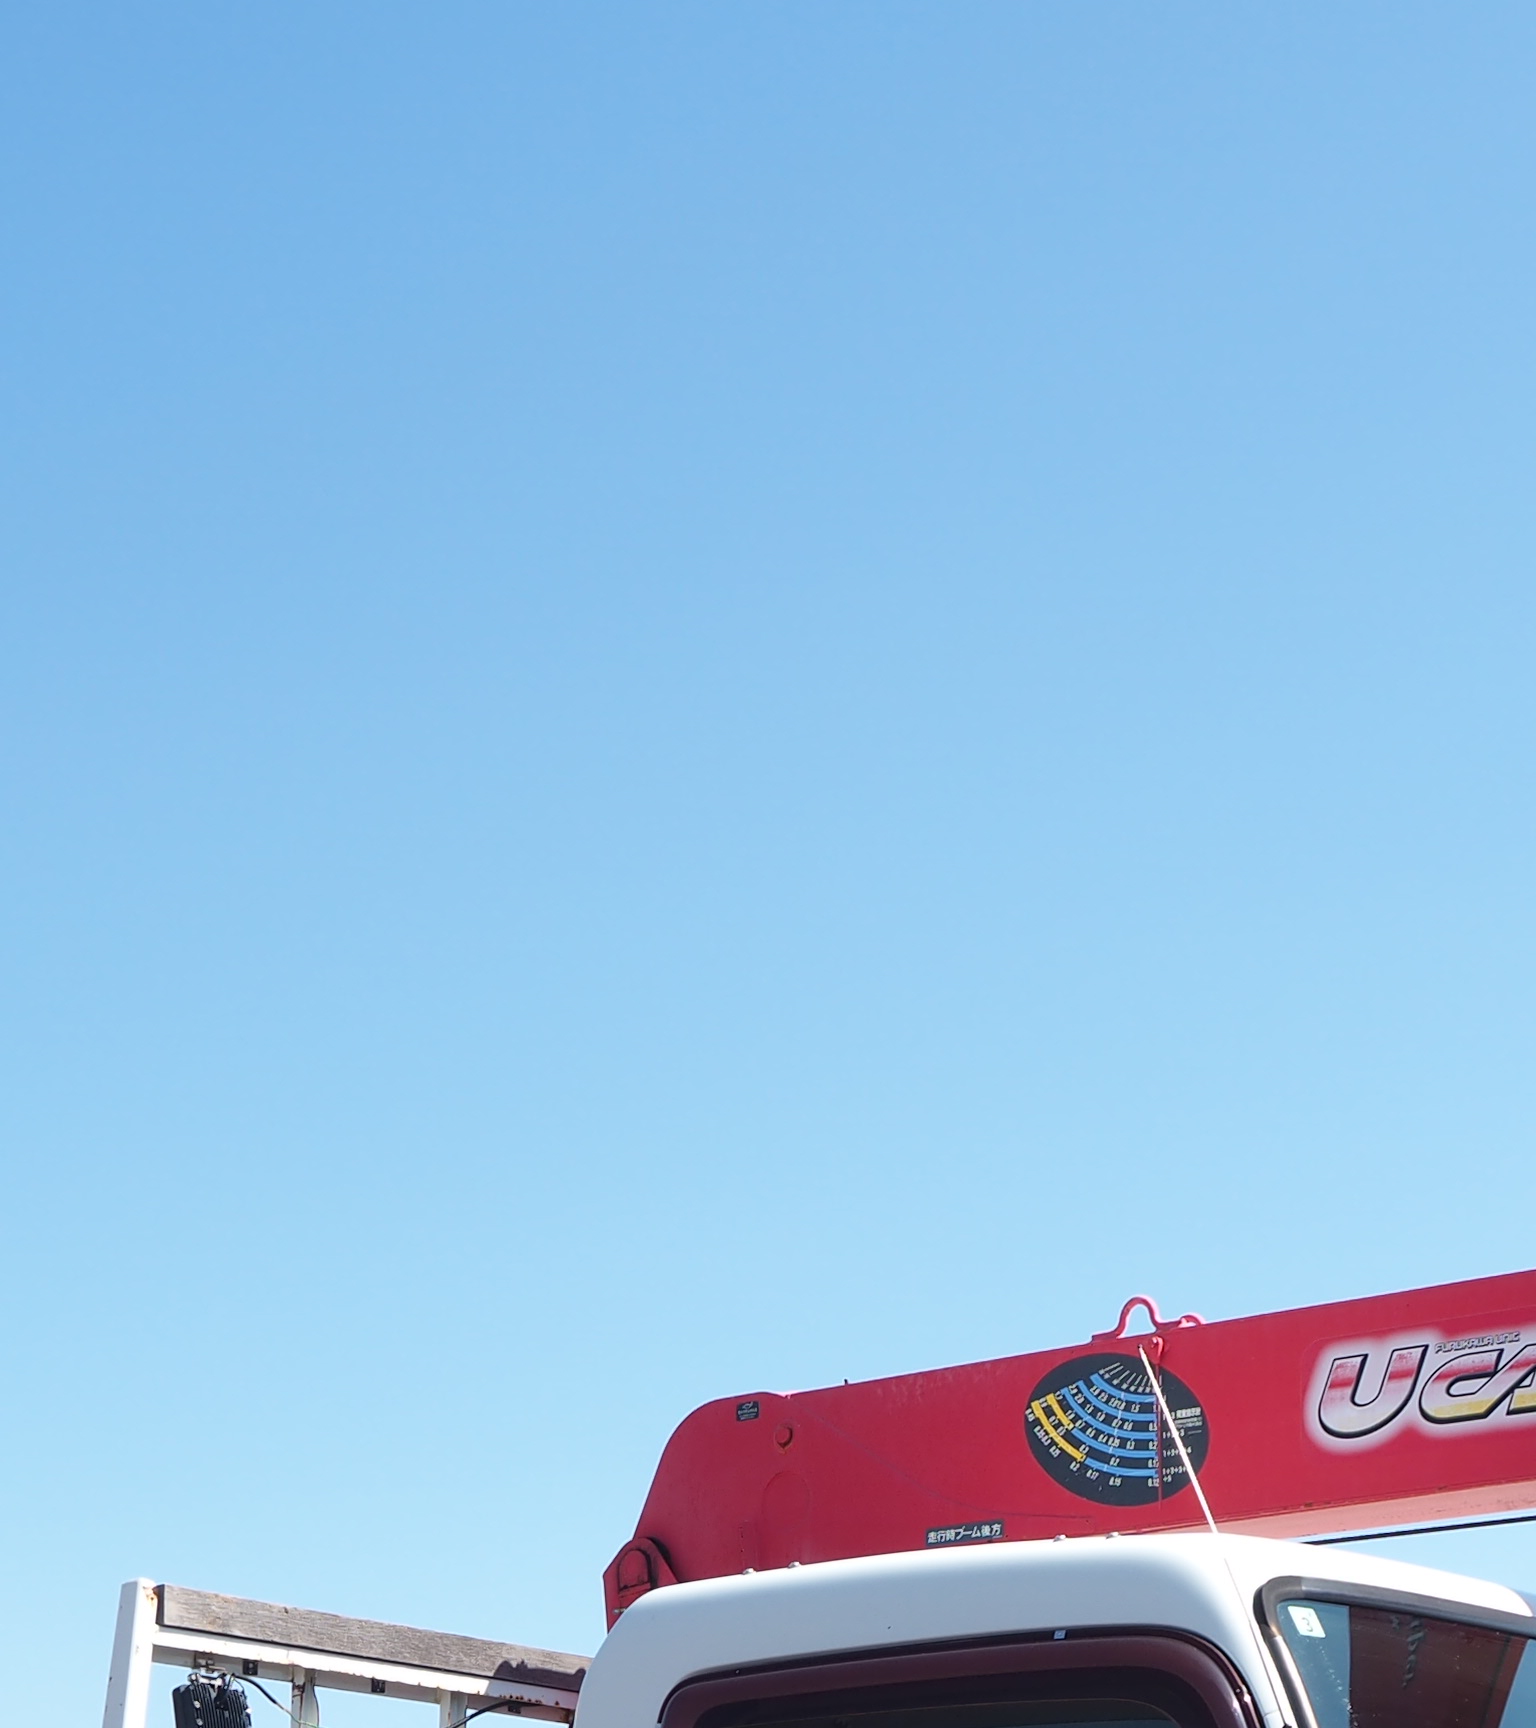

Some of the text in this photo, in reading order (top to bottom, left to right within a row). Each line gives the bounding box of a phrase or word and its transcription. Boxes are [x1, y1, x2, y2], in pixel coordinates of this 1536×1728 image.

[1435, 1331, 1520, 1354] FURUKAWA UNIC
[927, 1523, 1002, 1544] 走行時ブーム後方
